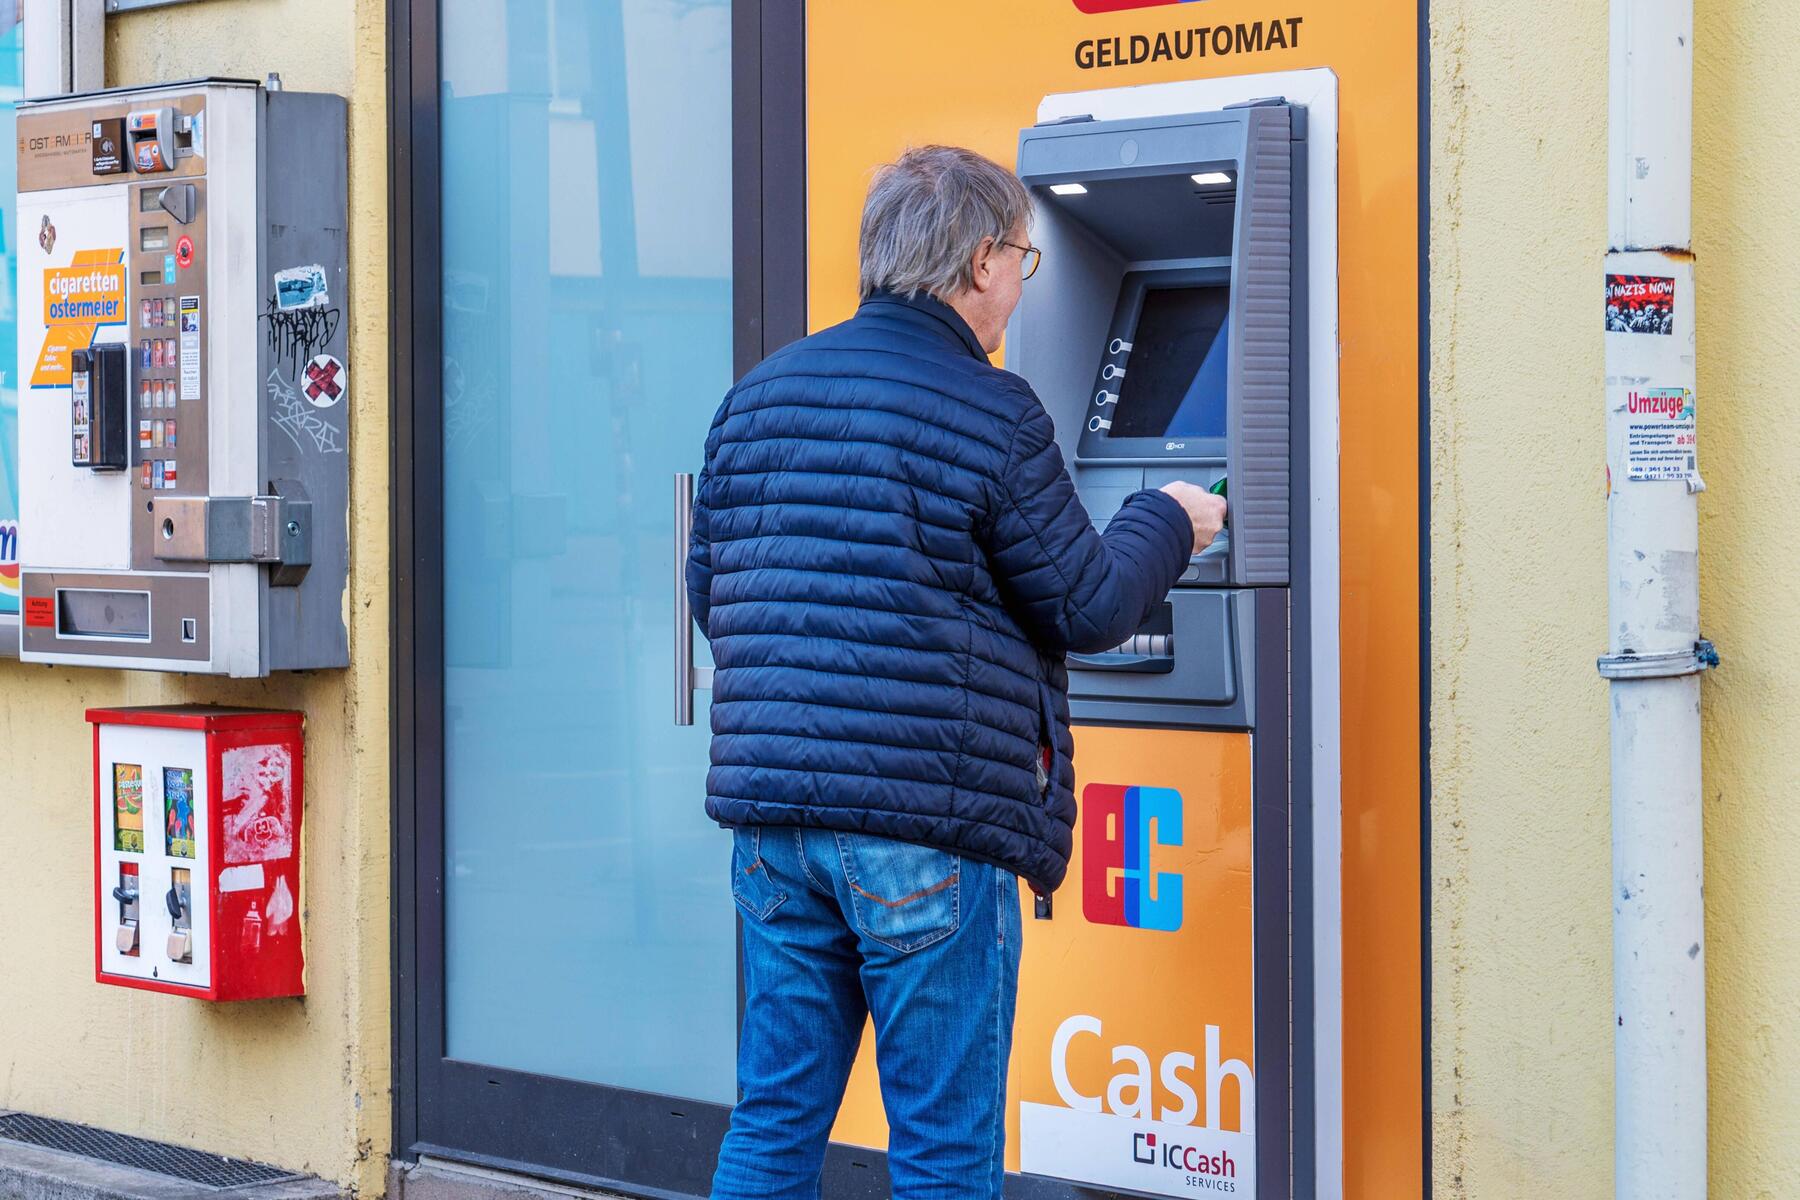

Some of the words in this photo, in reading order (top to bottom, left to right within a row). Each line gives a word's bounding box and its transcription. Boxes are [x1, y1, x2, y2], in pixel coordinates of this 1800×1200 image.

[1075, 17, 1303, 69] GELDAUTOMAT
[49, 272, 119, 300] cigaretten
[1614, 283, 1646, 297] NAZIS
[1649, 281, 1673, 294] NOW
[50, 296, 119, 319] ostermeier
[1628, 391, 1684, 419] Umzüge
[1051, 1014, 1254, 1135] Cash
[1163, 1143, 1235, 1178] ICCash
[1186, 1176, 1235, 1192] SERVICES
